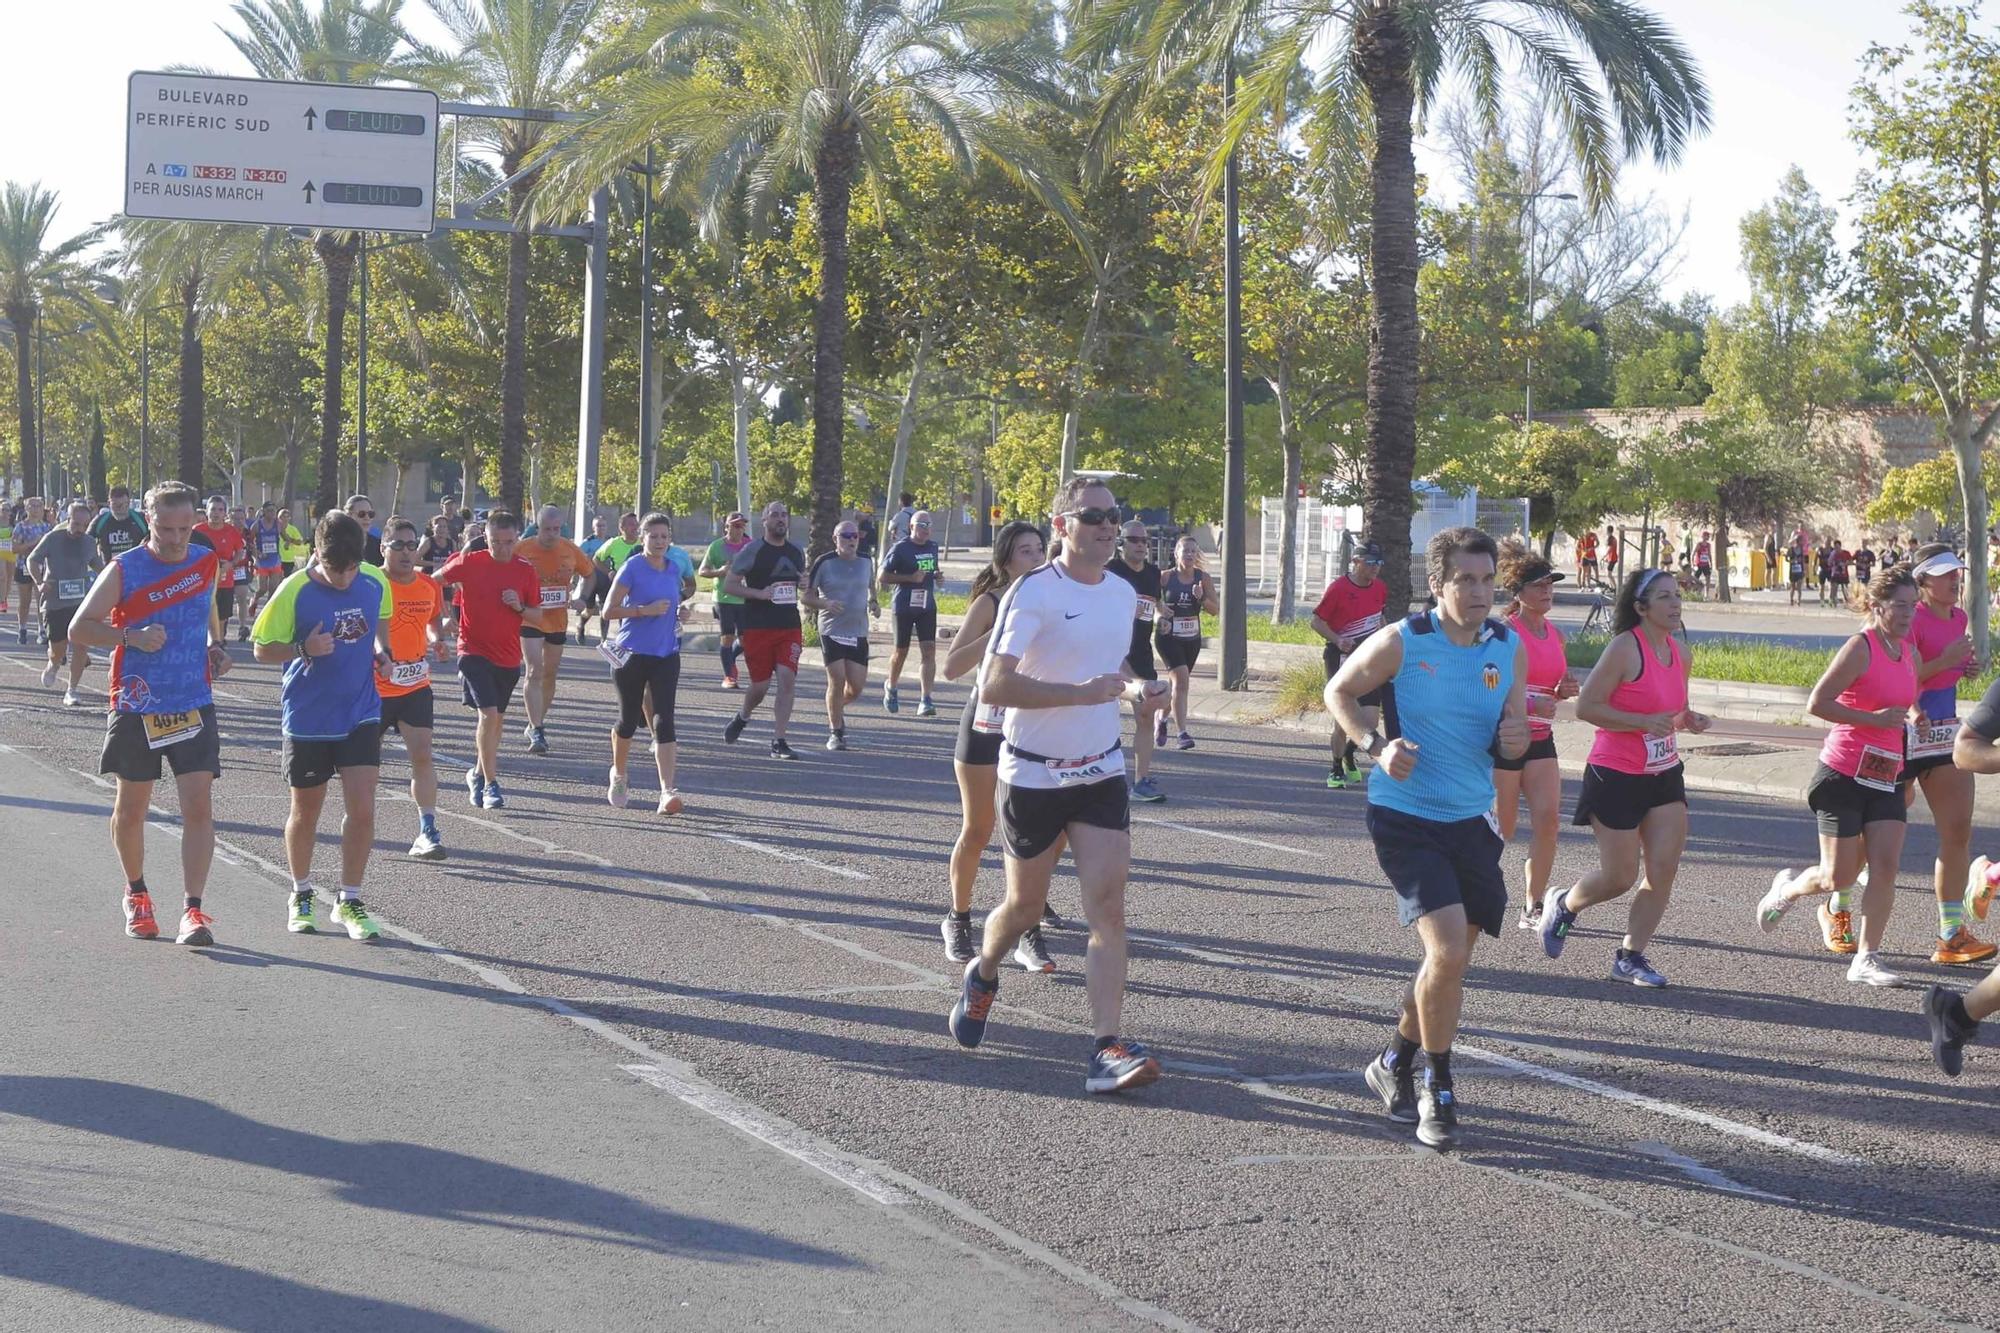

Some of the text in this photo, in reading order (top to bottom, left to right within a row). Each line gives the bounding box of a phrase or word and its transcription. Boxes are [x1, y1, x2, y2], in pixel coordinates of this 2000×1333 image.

[158, 89, 249, 106] BULEVARD
[235, 118, 270, 133] SUD
[347, 112, 402, 131] FLUID
[146, 163, 157, 176] A
[193, 166, 236, 180] N-332
[243, 169, 286, 183] N-340
[133, 182, 264, 201] PER AUSIAS MARCH
[345, 185, 400, 203] FLUID
[148, 572, 201, 602] Es posible
[396, 664, 422, 678] 7292
[1915, 728, 1953, 744] 952
